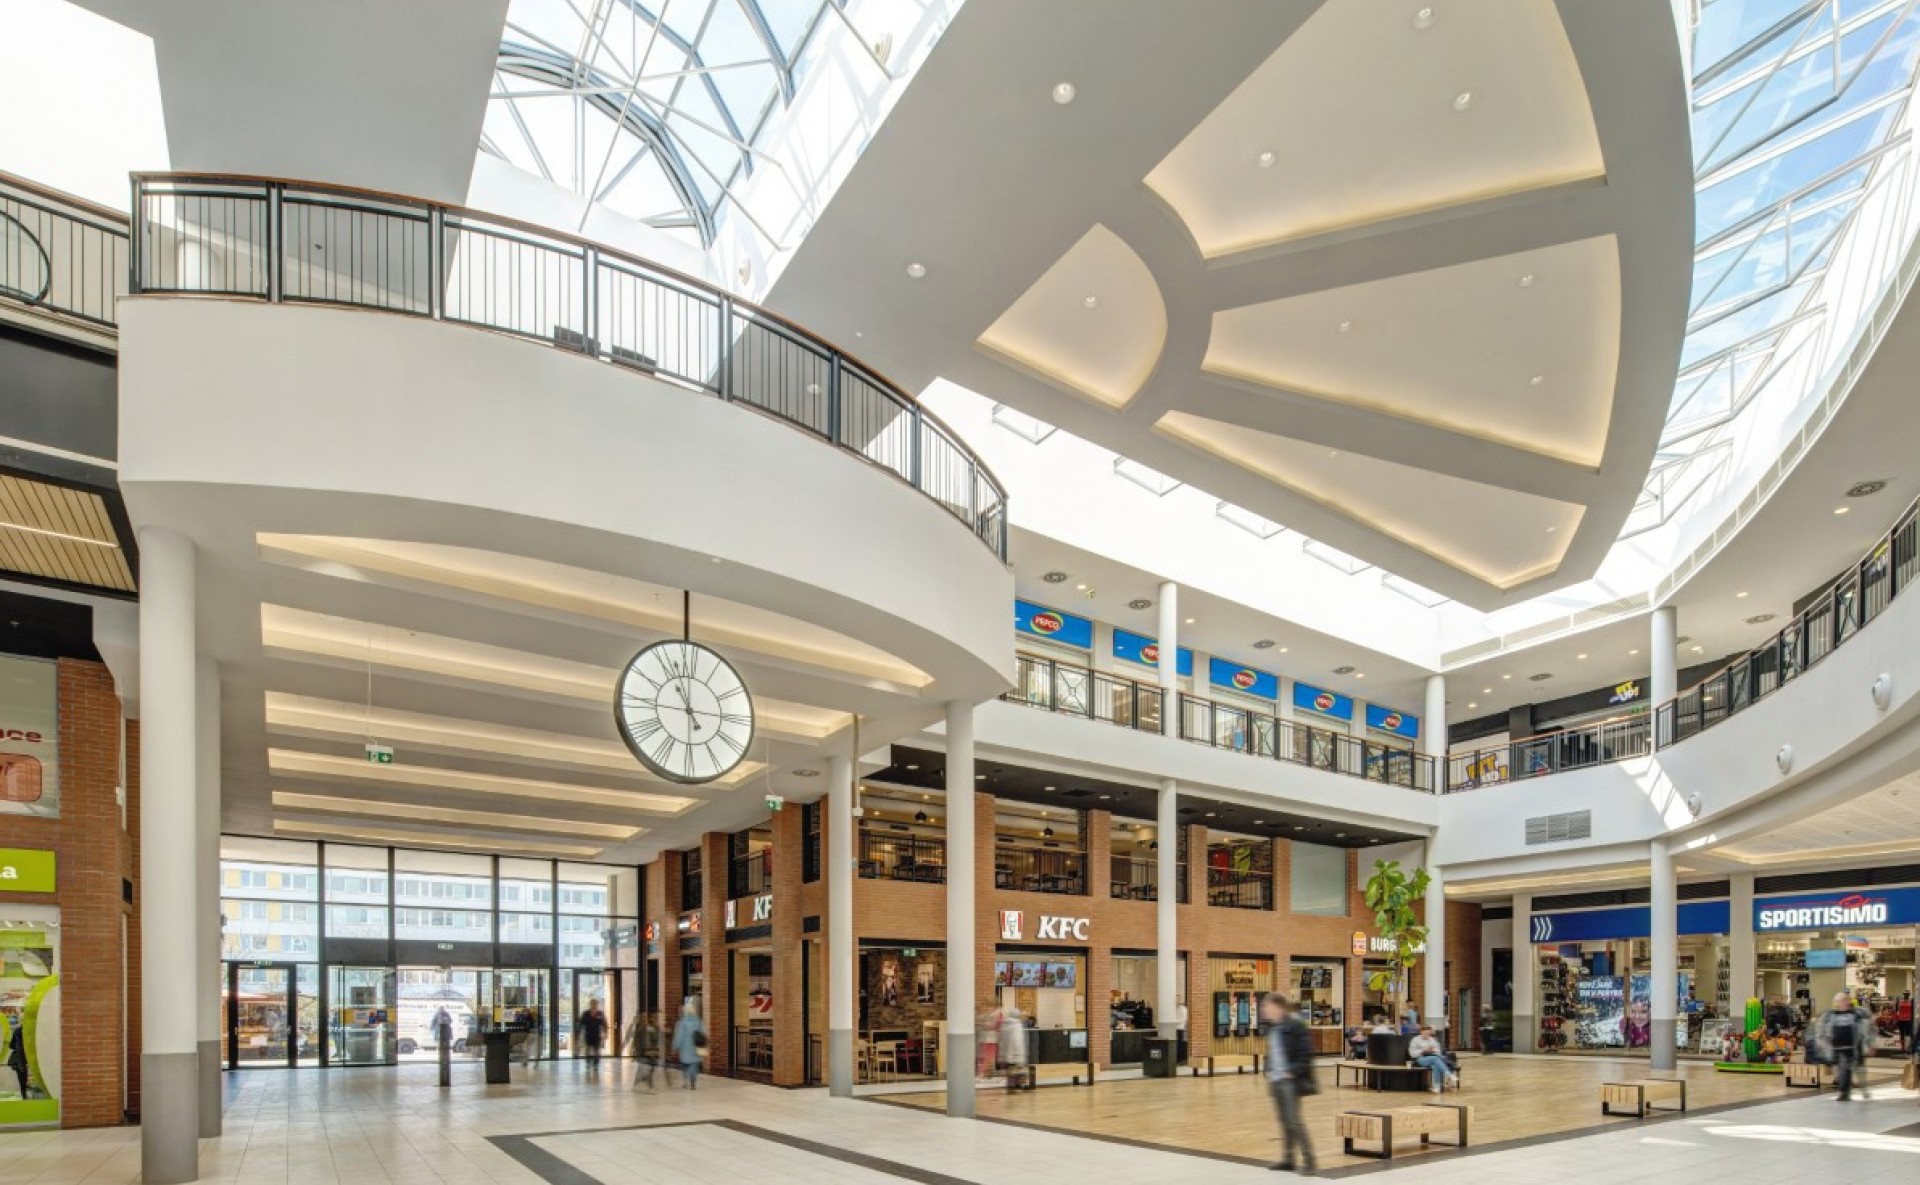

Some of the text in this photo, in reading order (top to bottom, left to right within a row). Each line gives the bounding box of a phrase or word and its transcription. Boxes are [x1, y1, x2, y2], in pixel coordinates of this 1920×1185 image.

[1035, 615, 1059, 629] PEPCO
[0, 728, 41, 743] ce
[1037, 915, 1090, 941] KFC
